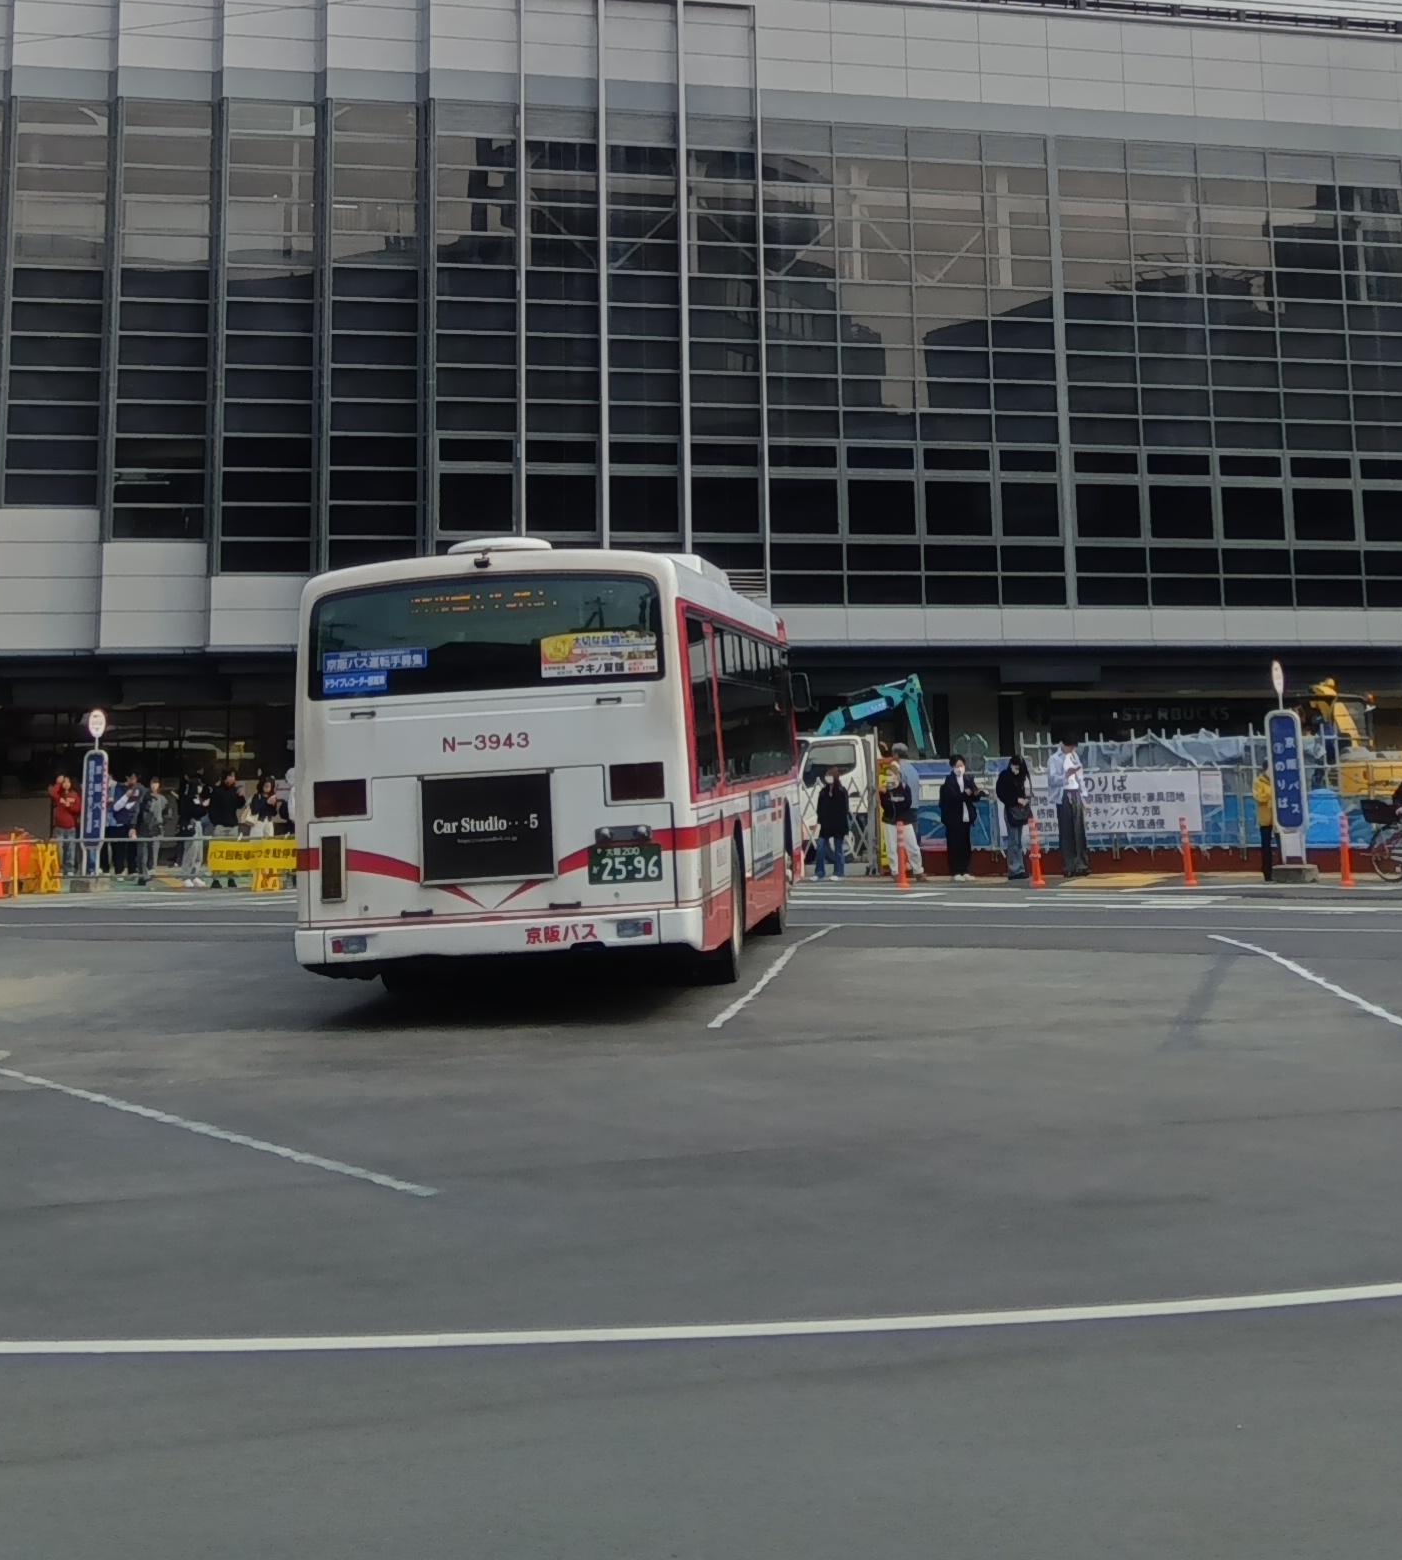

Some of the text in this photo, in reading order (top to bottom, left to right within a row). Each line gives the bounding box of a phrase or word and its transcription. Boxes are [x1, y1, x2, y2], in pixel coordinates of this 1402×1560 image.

[1121, 706, 1230, 721] STARBUCKS
[442, 731, 530, 753] N-3943
[433, 818, 459, 835] Car
[460, 815, 508, 833] Studio
[524, 923, 598, 945] 京阪バス
